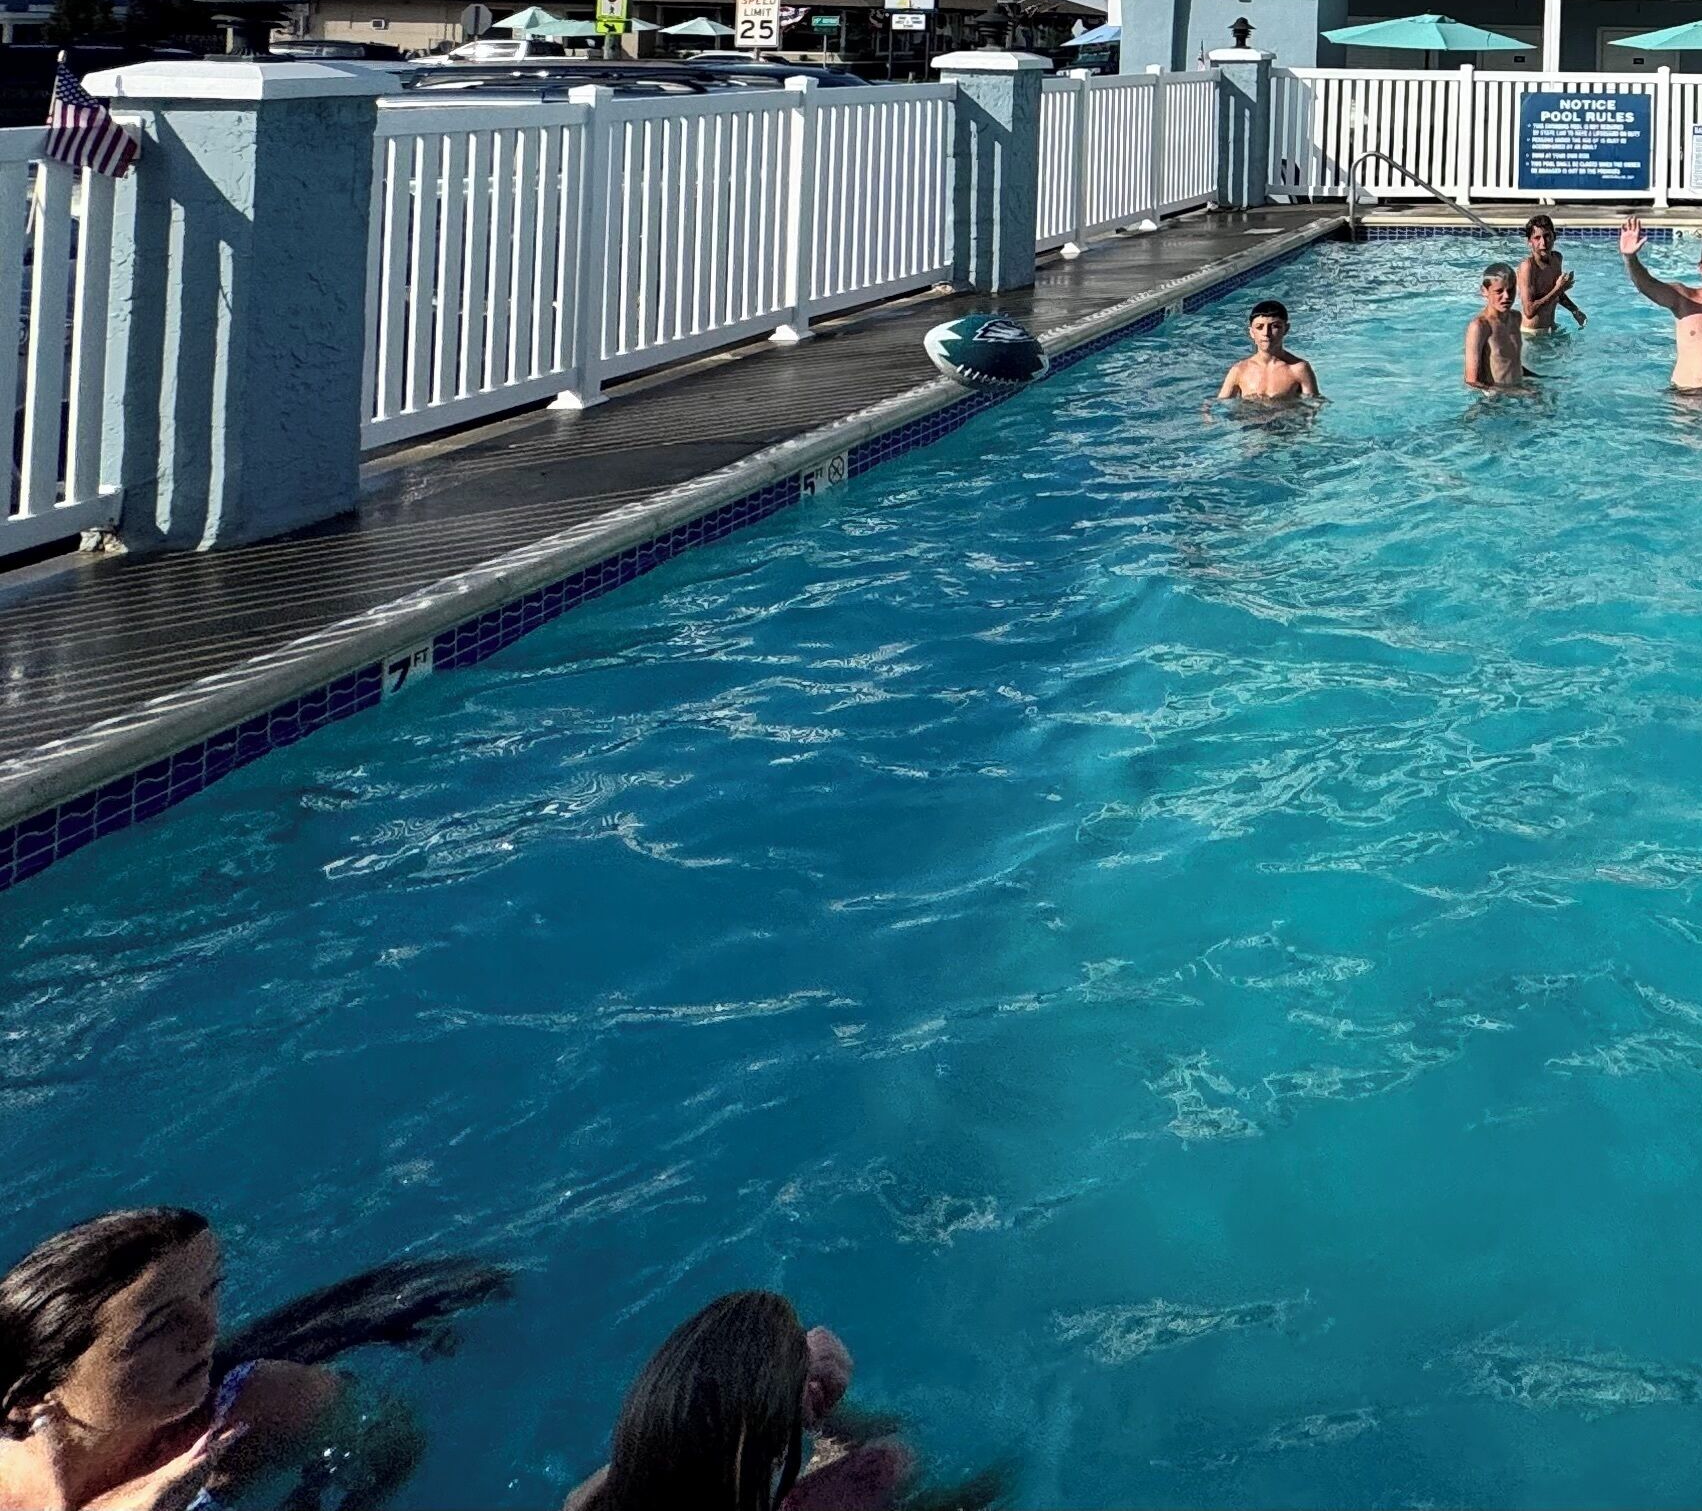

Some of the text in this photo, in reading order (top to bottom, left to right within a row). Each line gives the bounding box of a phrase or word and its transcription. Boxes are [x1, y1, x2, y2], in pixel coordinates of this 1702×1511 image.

[743, 7, 772, 17] LIMIT
[740, 19, 774, 40] 25
[1559, 99, 1616, 110] NOTICE
[1540, 111, 1635, 123] POOL RULES
[388, 646, 430, 694] 7 FT
